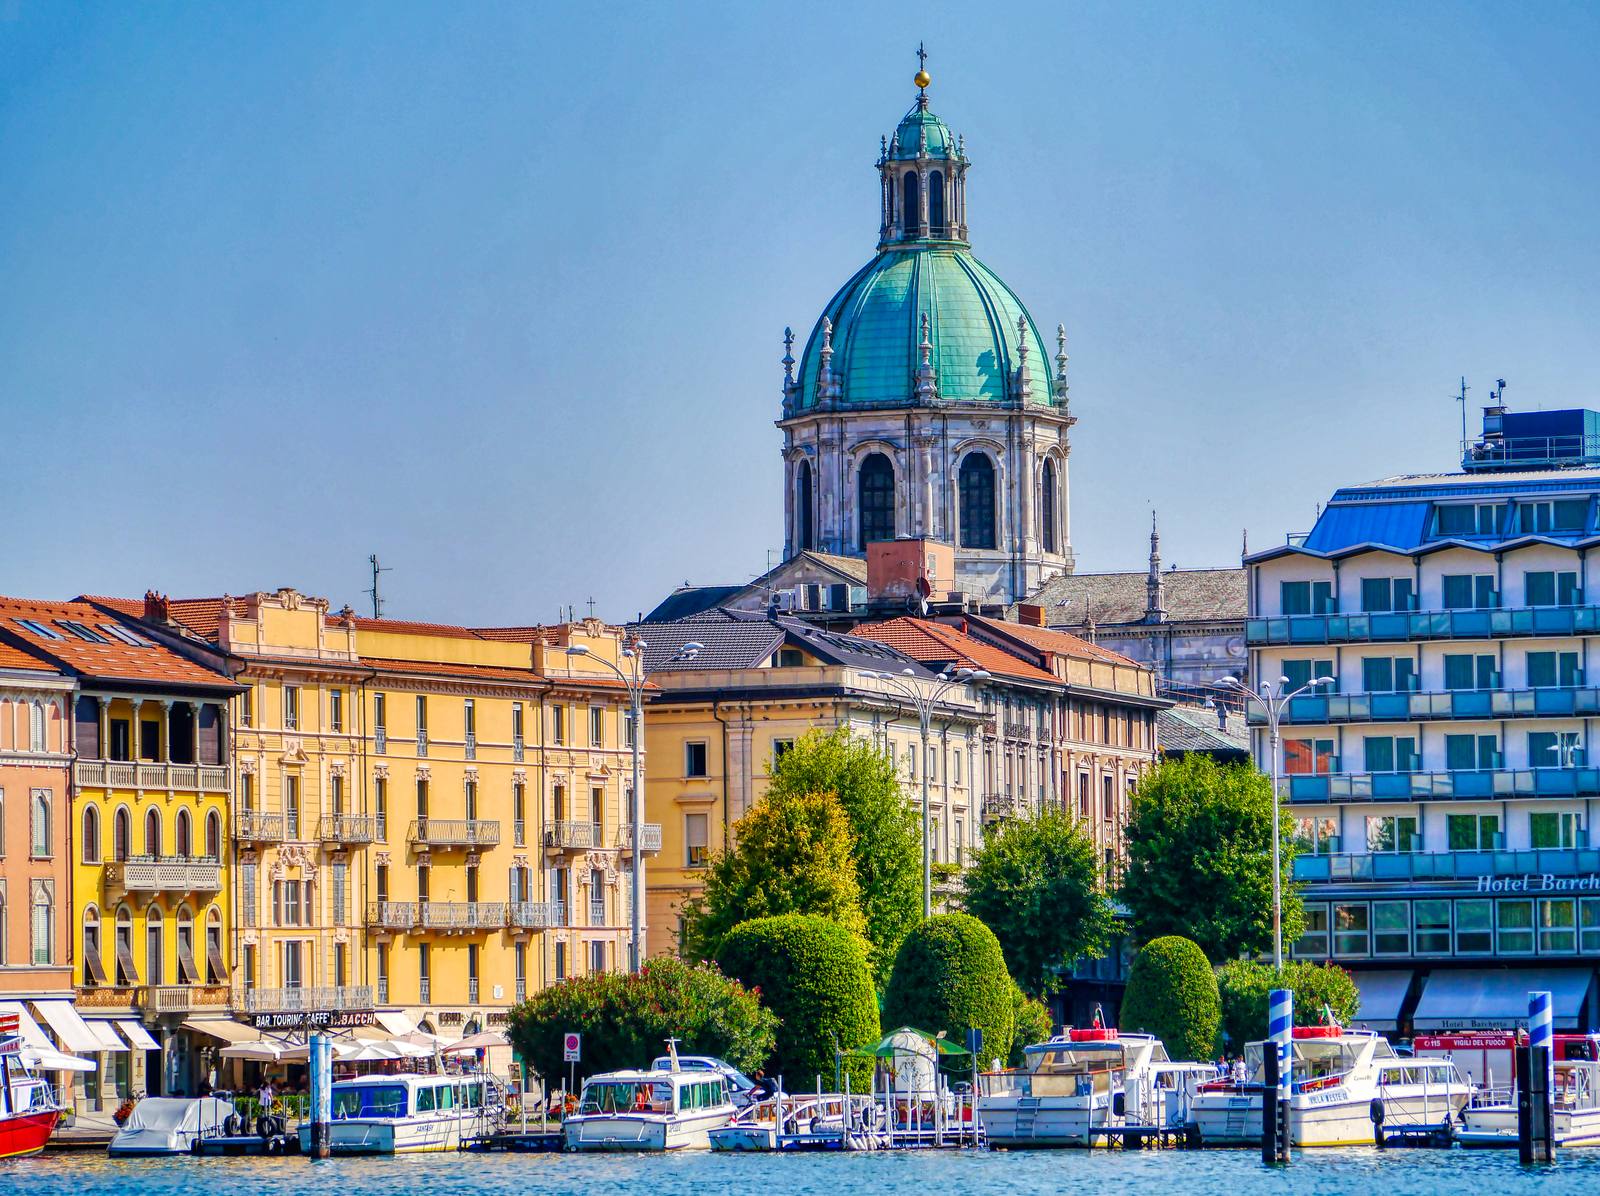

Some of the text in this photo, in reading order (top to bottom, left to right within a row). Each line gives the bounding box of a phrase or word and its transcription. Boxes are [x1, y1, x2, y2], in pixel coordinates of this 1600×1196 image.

[1476, 872, 1600, 892] Hotel Barch
[256, 1015, 270, 1027] BAR
[273, 1013, 303, 1026] TOURING
[1441, 1020, 1464, 1028] Hotel
